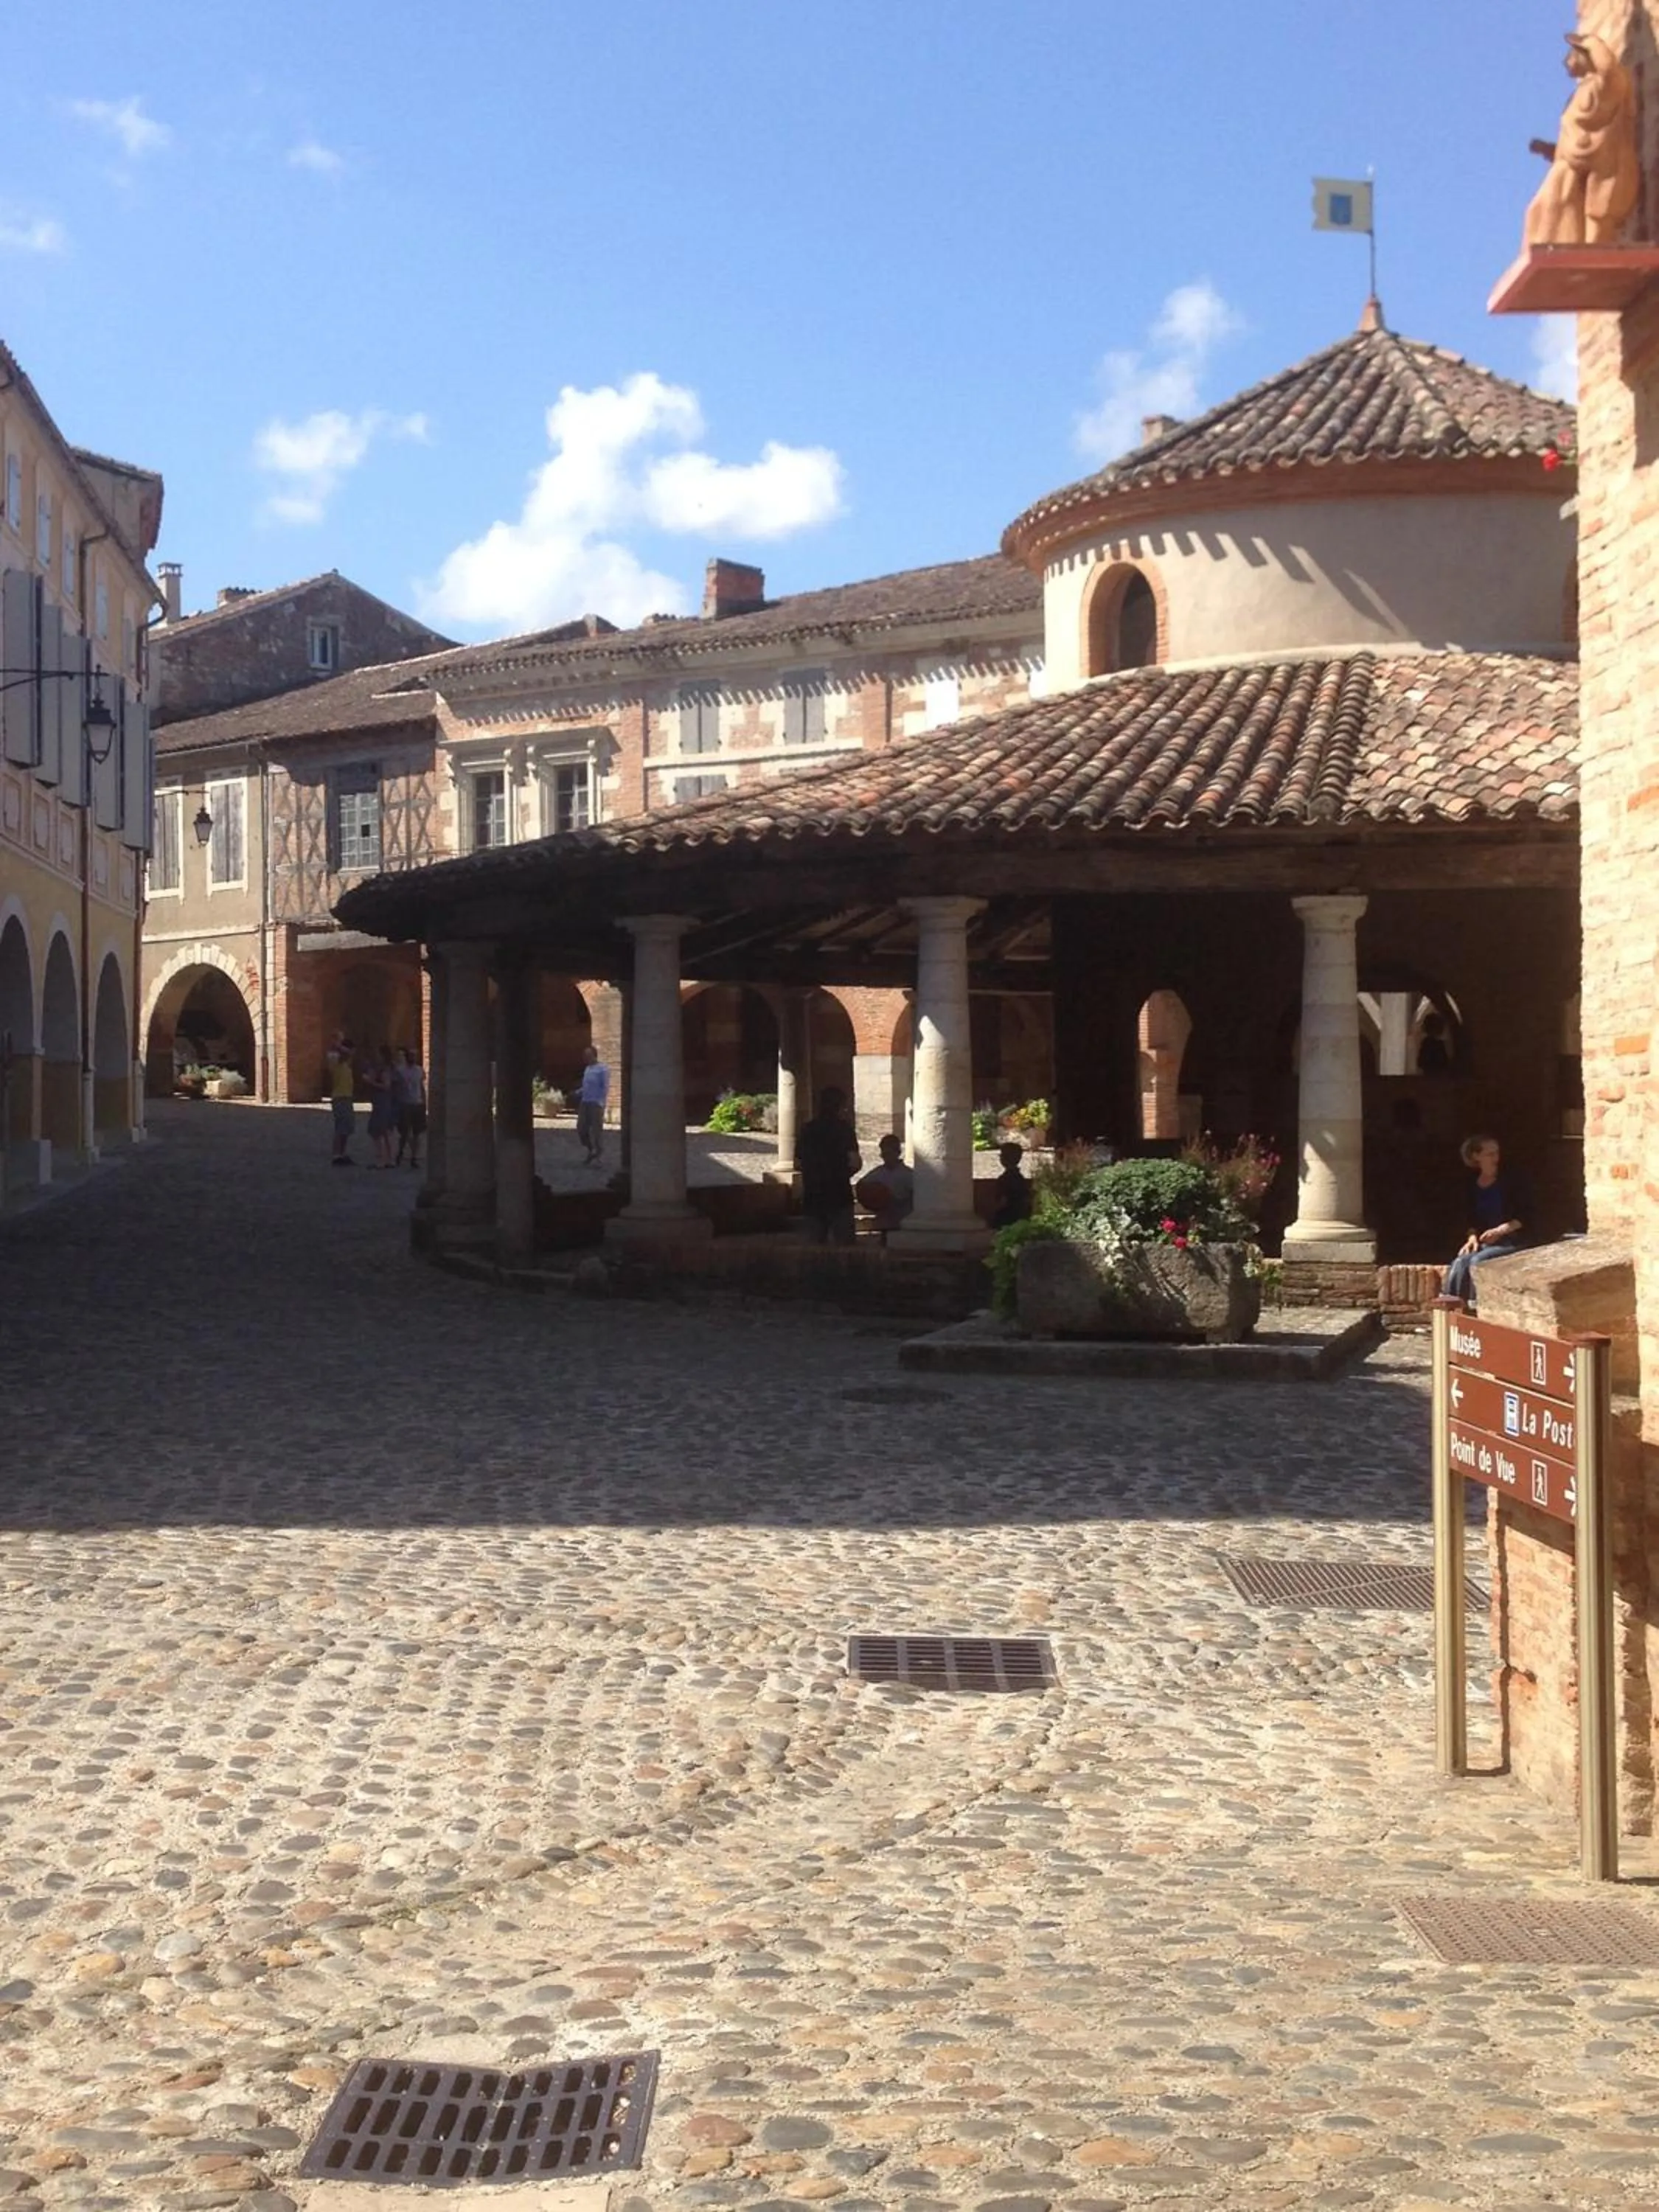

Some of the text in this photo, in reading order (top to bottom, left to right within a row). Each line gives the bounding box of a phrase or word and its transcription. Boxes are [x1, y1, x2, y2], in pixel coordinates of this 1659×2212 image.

[1450, 1326, 1481, 1359] Musée
[1522, 1402, 1575, 1450] La Post
[1450, 1432, 1516, 1484] Point de Vue
